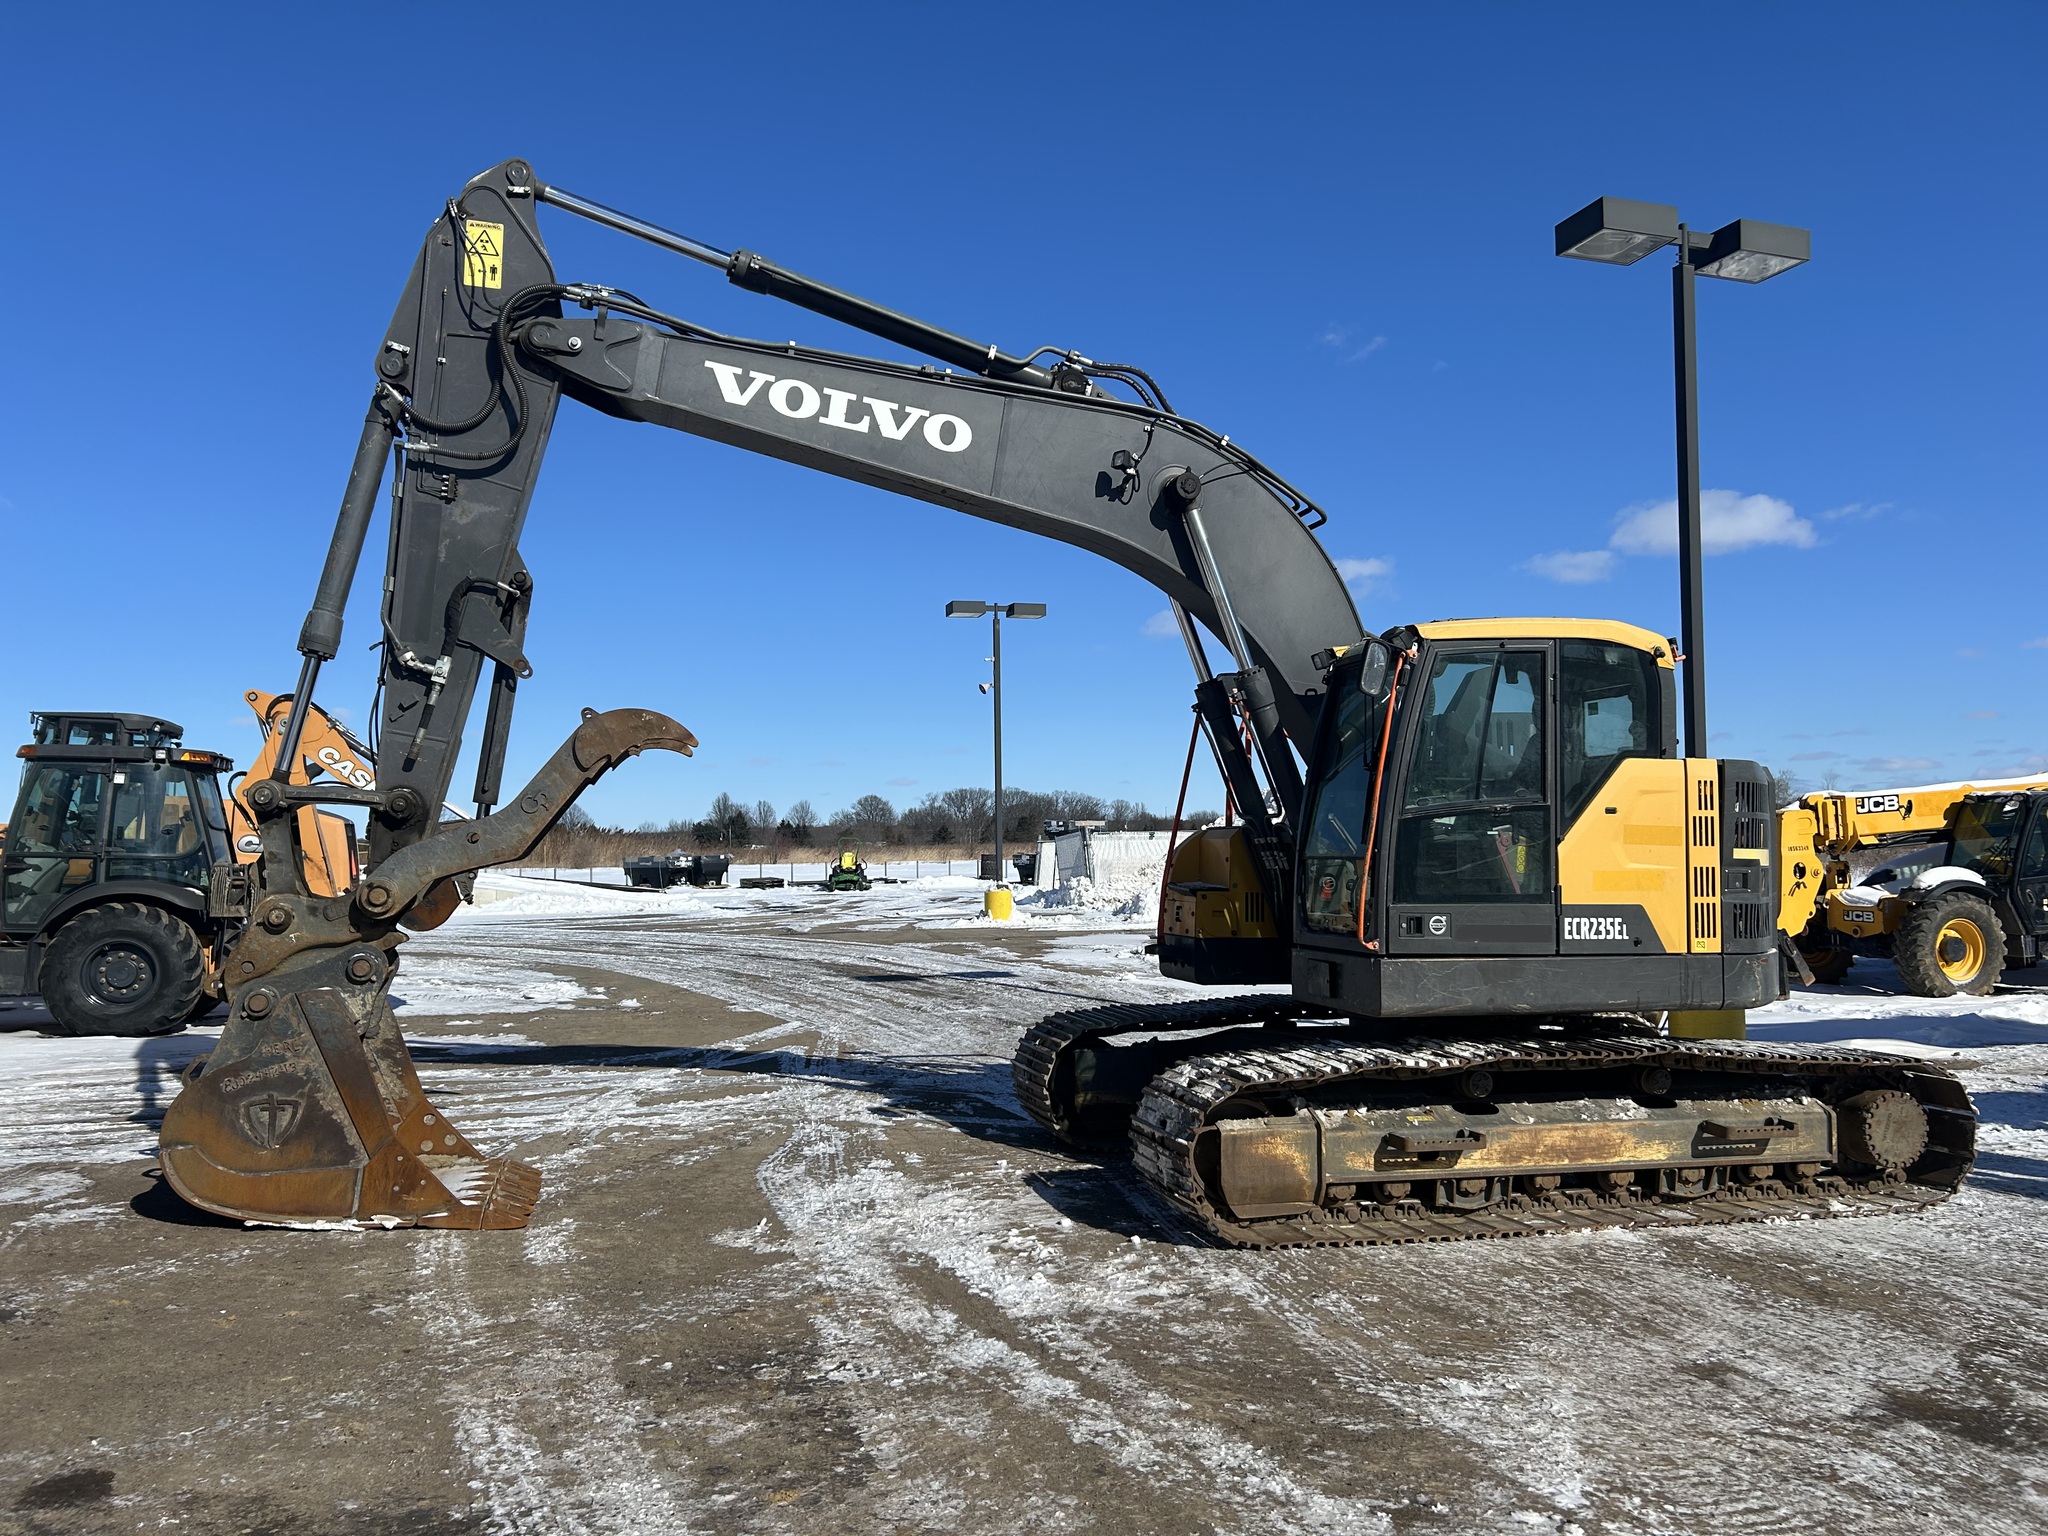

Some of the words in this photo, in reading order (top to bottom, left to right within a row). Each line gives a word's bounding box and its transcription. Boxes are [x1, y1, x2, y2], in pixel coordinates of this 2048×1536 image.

[475, 222, 501, 231] WARNING
[704, 360, 973, 453] VOLVO
[318, 746, 376, 791] CAS
[1857, 795, 1899, 814] JCB
[1843, 911, 1875, 922] JCB
